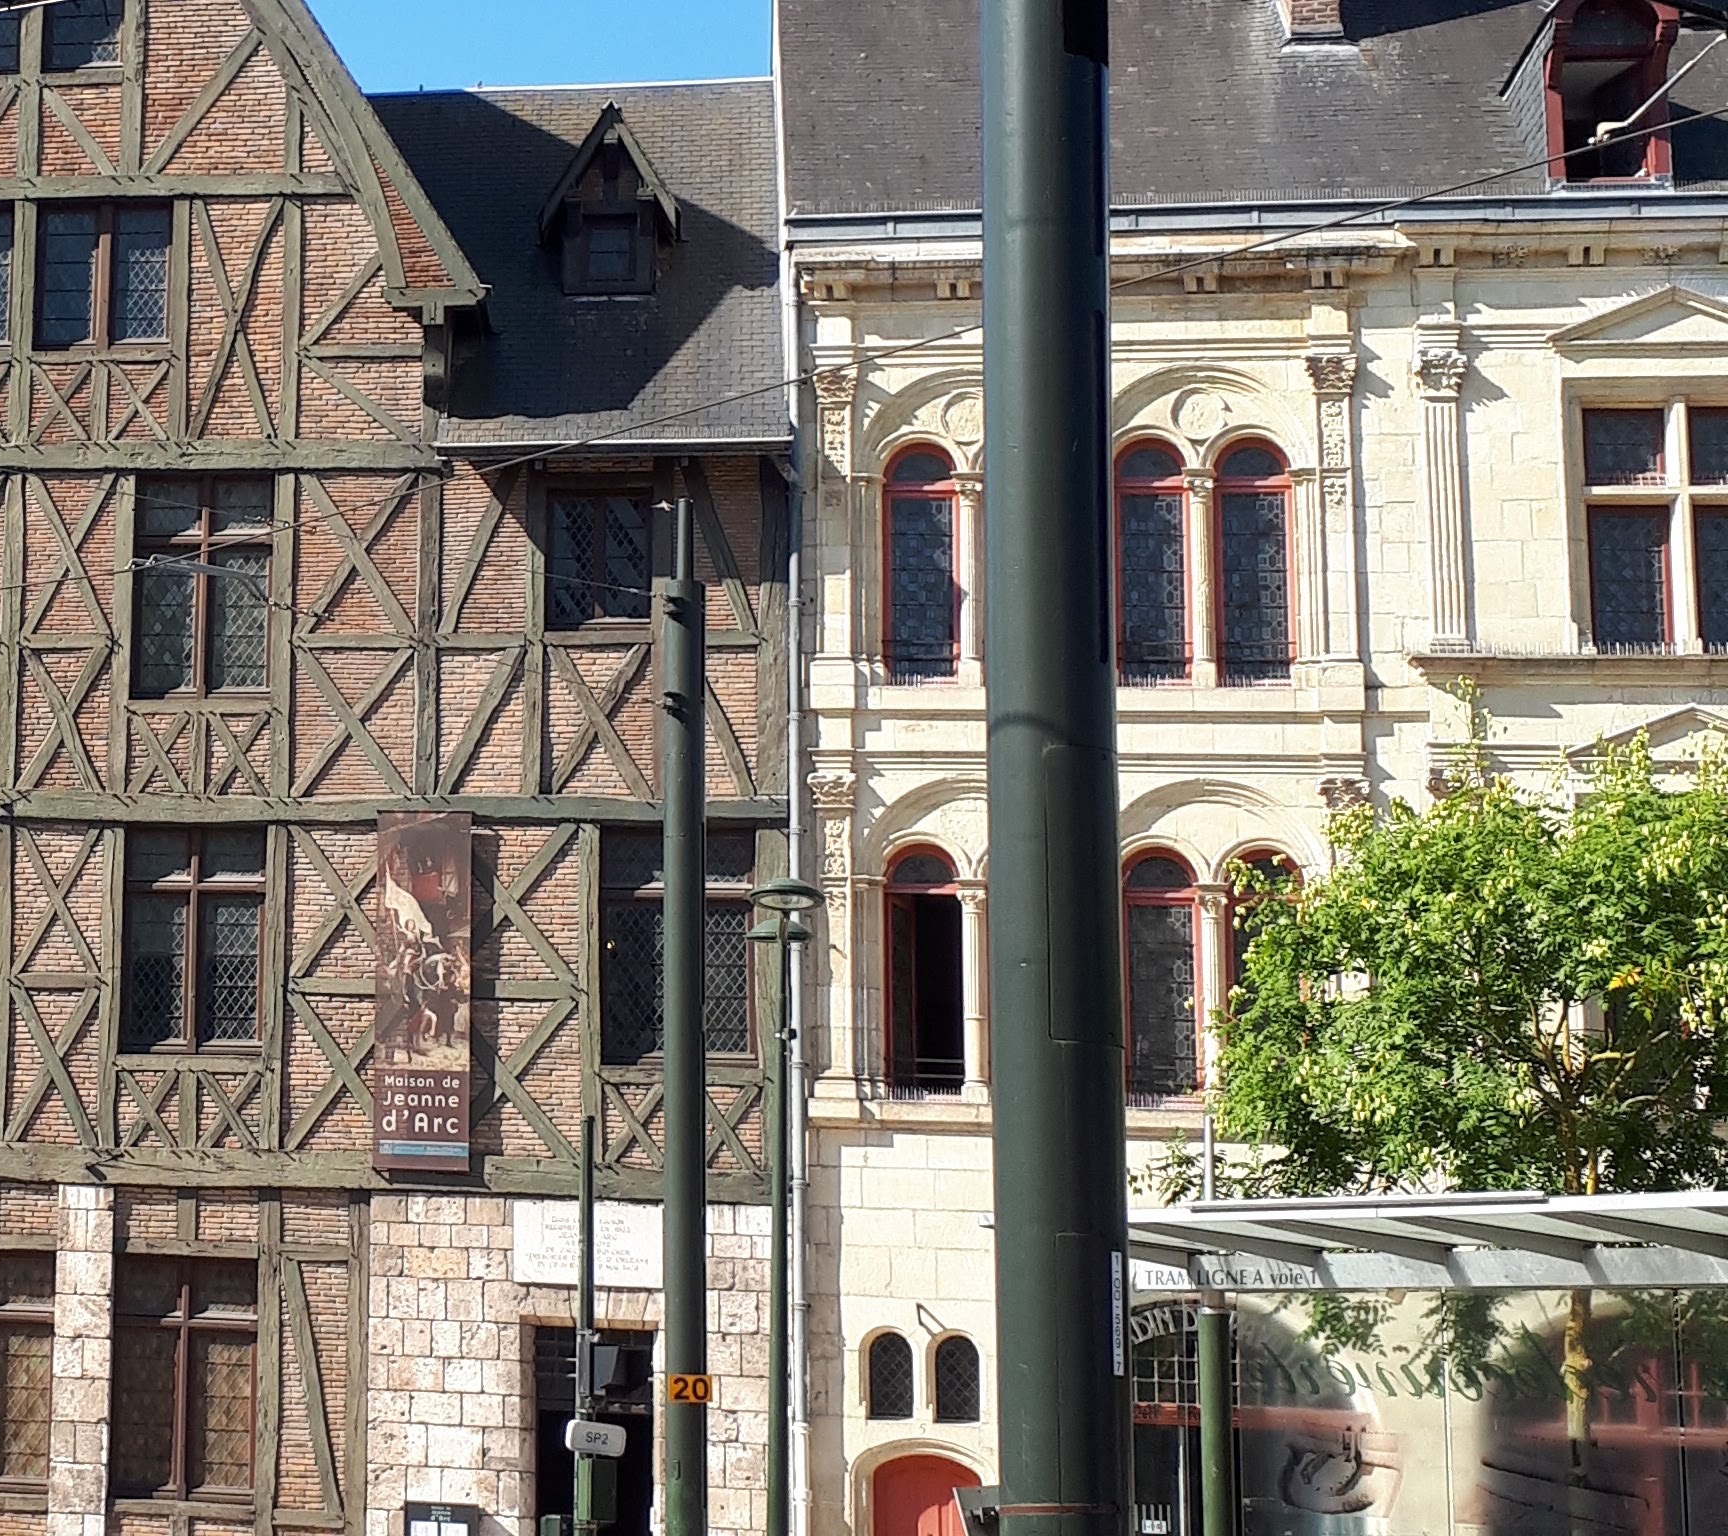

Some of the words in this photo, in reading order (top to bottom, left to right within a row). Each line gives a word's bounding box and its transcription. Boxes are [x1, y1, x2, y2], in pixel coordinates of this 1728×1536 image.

[384, 1074, 435, 1088] Maison
[441, 1075, 460, 1089] de
[382, 1090, 460, 1108] Jeanne
[381, 1109, 460, 1134] d'Arc
[1196, 1269, 1248, 1286] LIGNE
[1253, 1269, 1265, 1285] A
[1270, 1267, 1303, 1286] voie
[673, 1377, 709, 1401] 20
[585, 1431, 609, 1445] SP2
